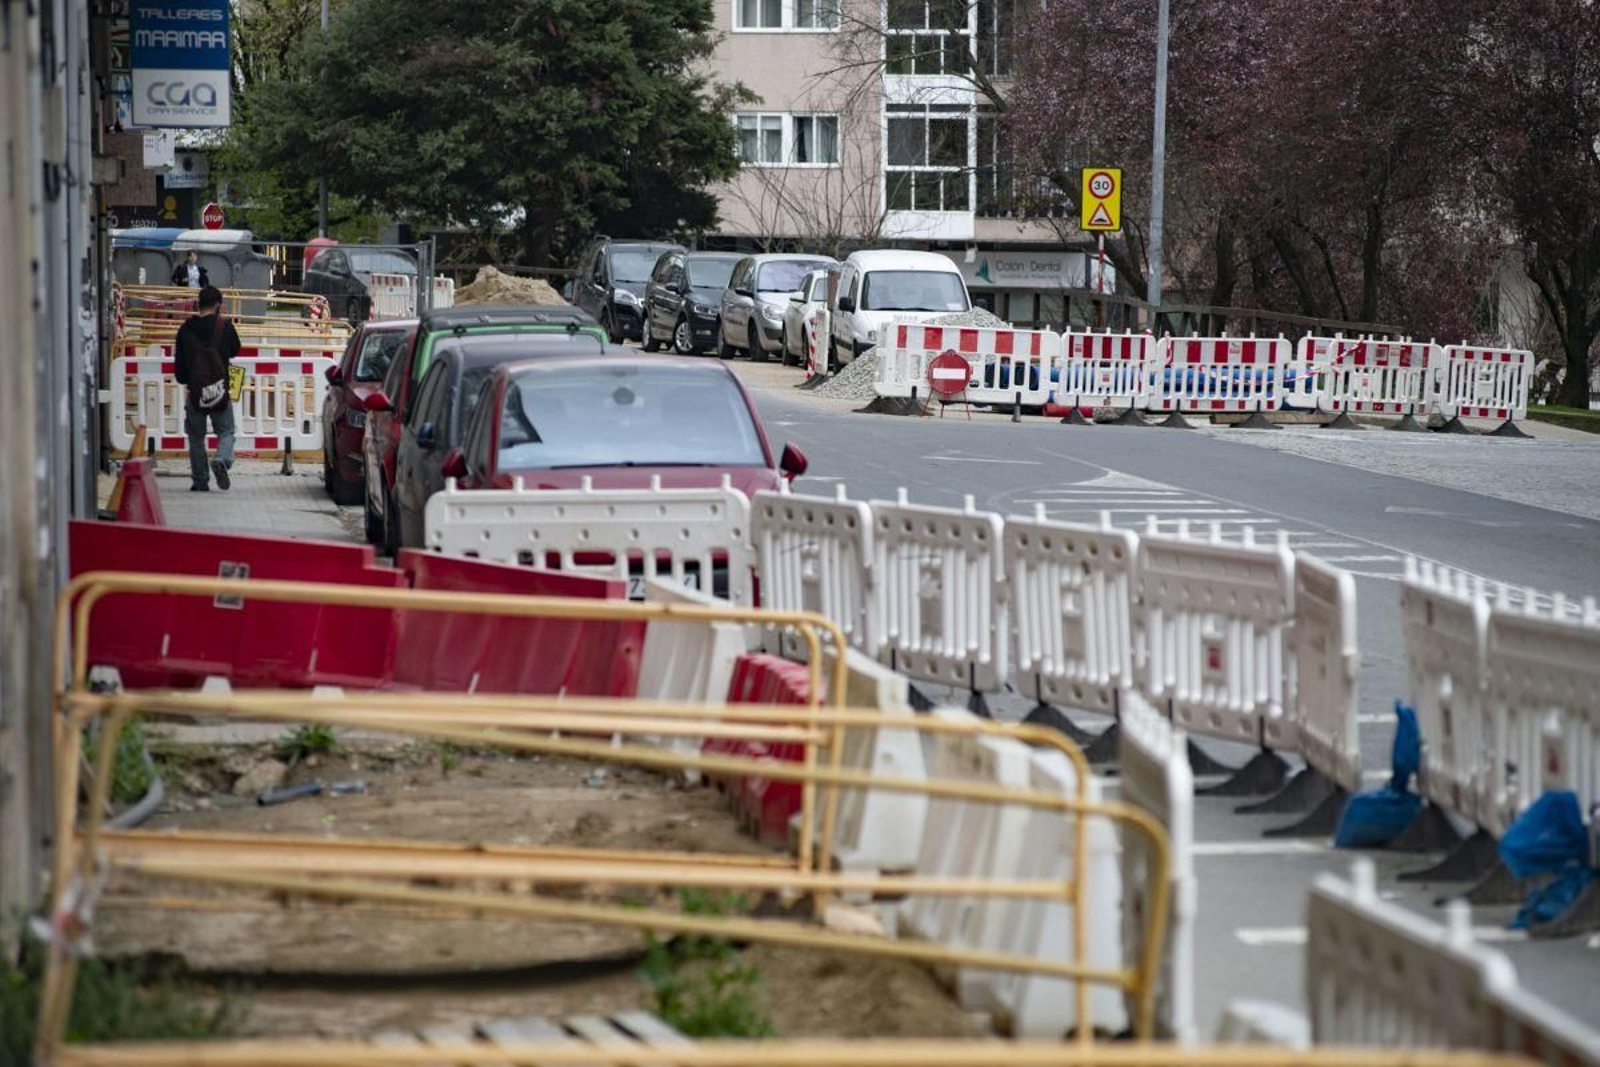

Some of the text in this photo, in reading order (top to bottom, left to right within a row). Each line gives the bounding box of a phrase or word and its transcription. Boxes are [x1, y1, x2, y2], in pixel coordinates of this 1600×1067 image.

[138, 8, 223, 21] TALLERES
[135, 30, 226, 48] MARIMAR
[147, 107, 217, 115] CAR SERVICE
[1094, 181, 1109, 190] 30
[205, 214, 222, 222] STOP
